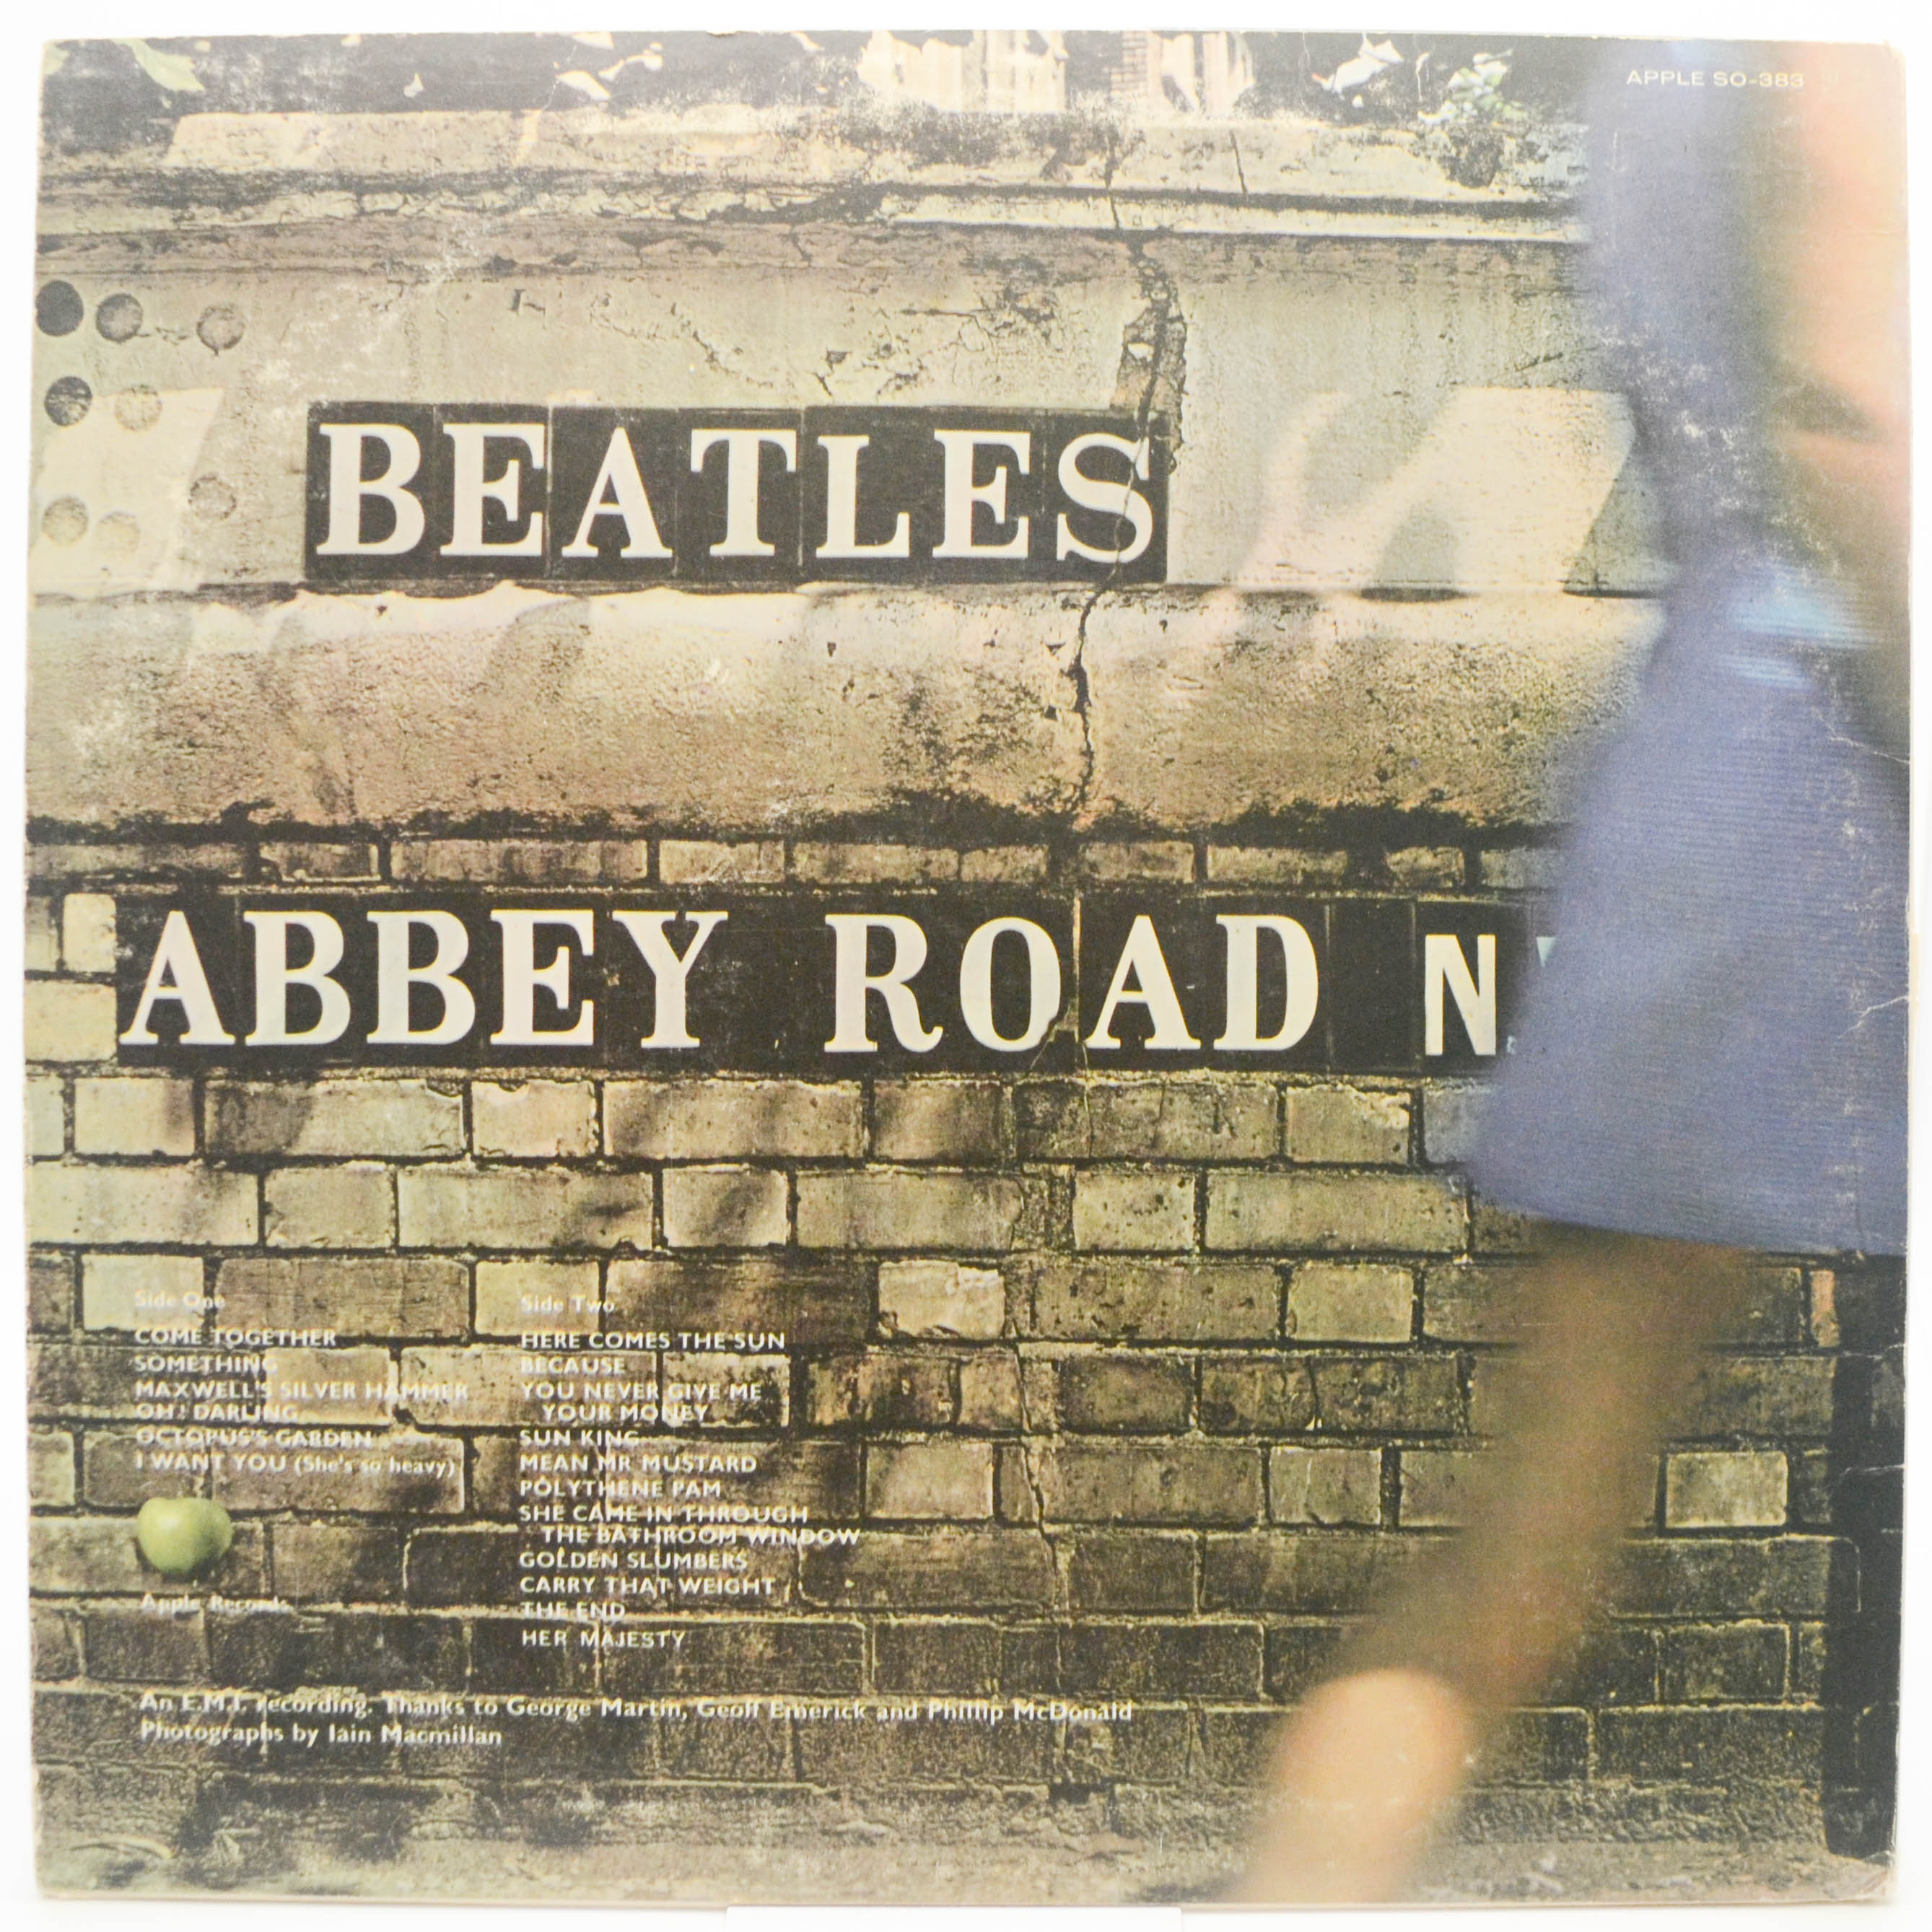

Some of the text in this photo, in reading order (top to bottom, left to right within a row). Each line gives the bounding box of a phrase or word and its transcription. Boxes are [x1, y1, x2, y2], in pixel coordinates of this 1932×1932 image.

[1626, 70, 1804, 87] APPLE SO-383
[315, 422, 1154, 563] BEATLES
[119, 910, 728, 1048] ABBEY
[824, 914, 1319, 1052] ROAD
[183, 1291, 226, 1311] One
[520, 1295, 616, 1314] Side Two
[134, 1327, 337, 1347] COME TOGETHER
[520, 1332, 786, 1350] HERE COMES THE SUN
[134, 1354, 279, 1375] SOMETHING
[520, 1355, 626, 1374] BECAUSE
[135, 1381, 468, 1401] MAXWELL'S SILVER HAMMER
[520, 1382, 762, 1401] YOU NEVER GIVE ME
[194, 1404, 299, 1423] DARLING
[541, 1404, 710, 1423] YOUR MONEY
[135, 1428, 372, 1448] OCTOPUS'S GARDEN
[519, 1429, 640, 1447] SUN KING
[136, 1453, 456, 1479] I WANT YOU (She's so heavy)
[520, 1454, 758, 1473] MEAN MR MUSTARD
[520, 1479, 722, 1498] POLYTHENE PAM
[519, 1505, 808, 1524] SHE CAME IN THROUGH
[542, 1526, 862, 1547] THE BATHROOM WINDOW
[519, 1551, 749, 1570] GOLDEN SLUMBERS
[520, 1576, 777, 1596] CARRY THAT WEIGHT
[520, 1601, 626, 1620] THE END
[522, 1629, 686, 1649] HER MAJESTY
[140, 1692, 173, 1713] An
[385, 1695, 465, 1715] Thanks
[473, 1697, 498, 1715] to
[507, 1697, 591, 1723] George
[601, 1697, 688, 1721] Martin,
[696, 1698, 759, 1719] Geoff
[769, 1700, 865, 1720] Emerick
[876, 1701, 918, 1721] and
[1014, 1700, 1132, 1722] McDonald
[141, 1720, 502, 1748] Photographs by Iain Macmillan
